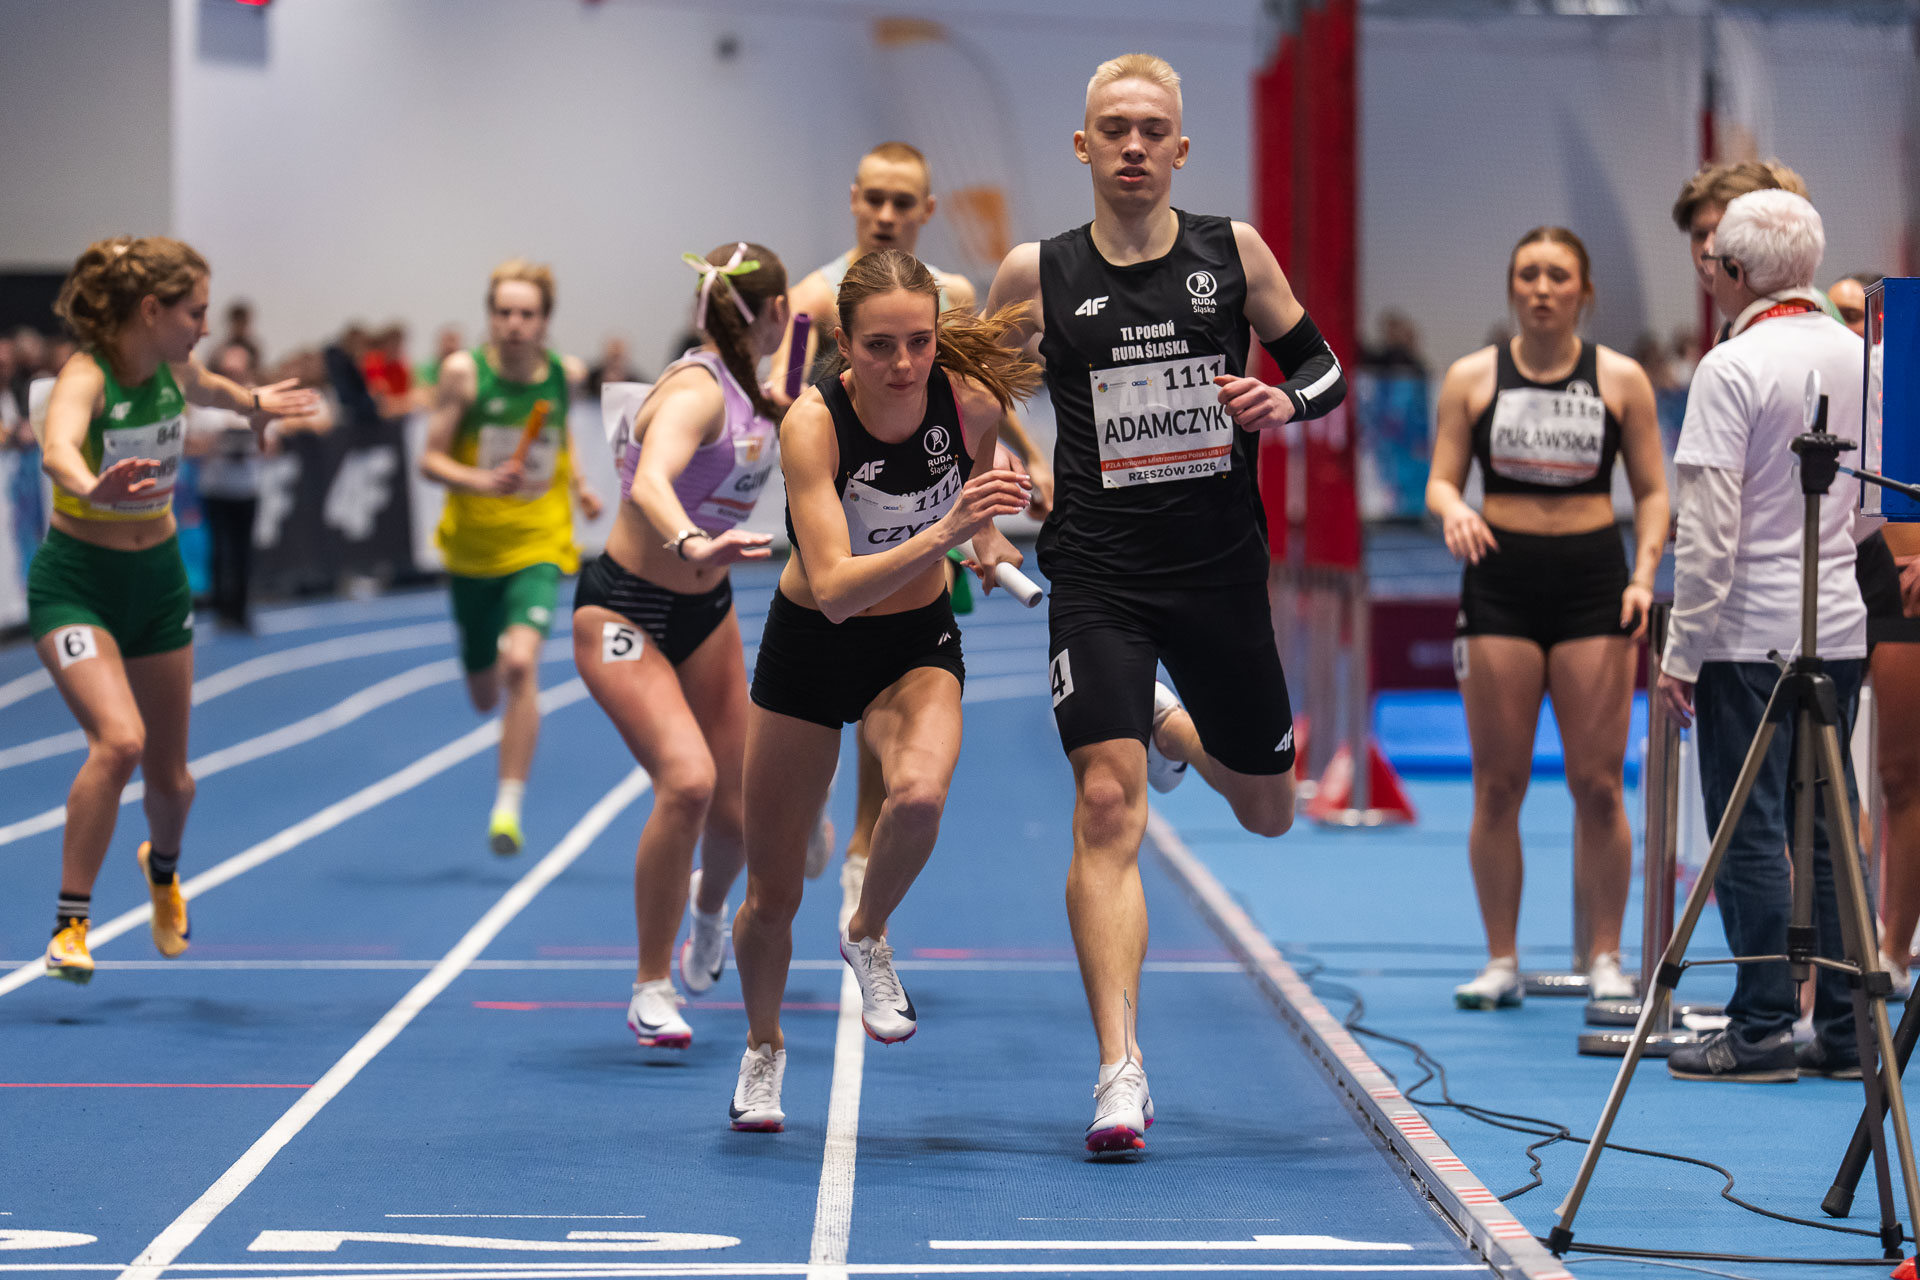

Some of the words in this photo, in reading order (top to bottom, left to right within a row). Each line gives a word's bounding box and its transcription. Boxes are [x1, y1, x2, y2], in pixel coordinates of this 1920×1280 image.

[1191, 297, 1217, 306] RUDA
[1193, 305, 1216, 314] Śląska
[1120, 327, 1135, 341] TL
[1135, 319, 1175, 340] POGOŃ
[1111, 343, 1144, 362] RUDA
[1145, 340, 1190, 359] ŚLĄSKA
[1163, 361, 1221, 391] 1111
[1104, 405, 1228, 444] ADAMCZYK
[927, 453, 953, 468] RUDA
[930, 463, 952, 476] Śląska
[1128, 465, 1186, 482] RZESZÓW
[1188, 461, 1217, 474] 2026
[914, 468, 961, 513] 1112
[64, 630, 86, 658] 6
[612, 628, 635, 656] 5
[1052, 658, 1066, 698] 4
